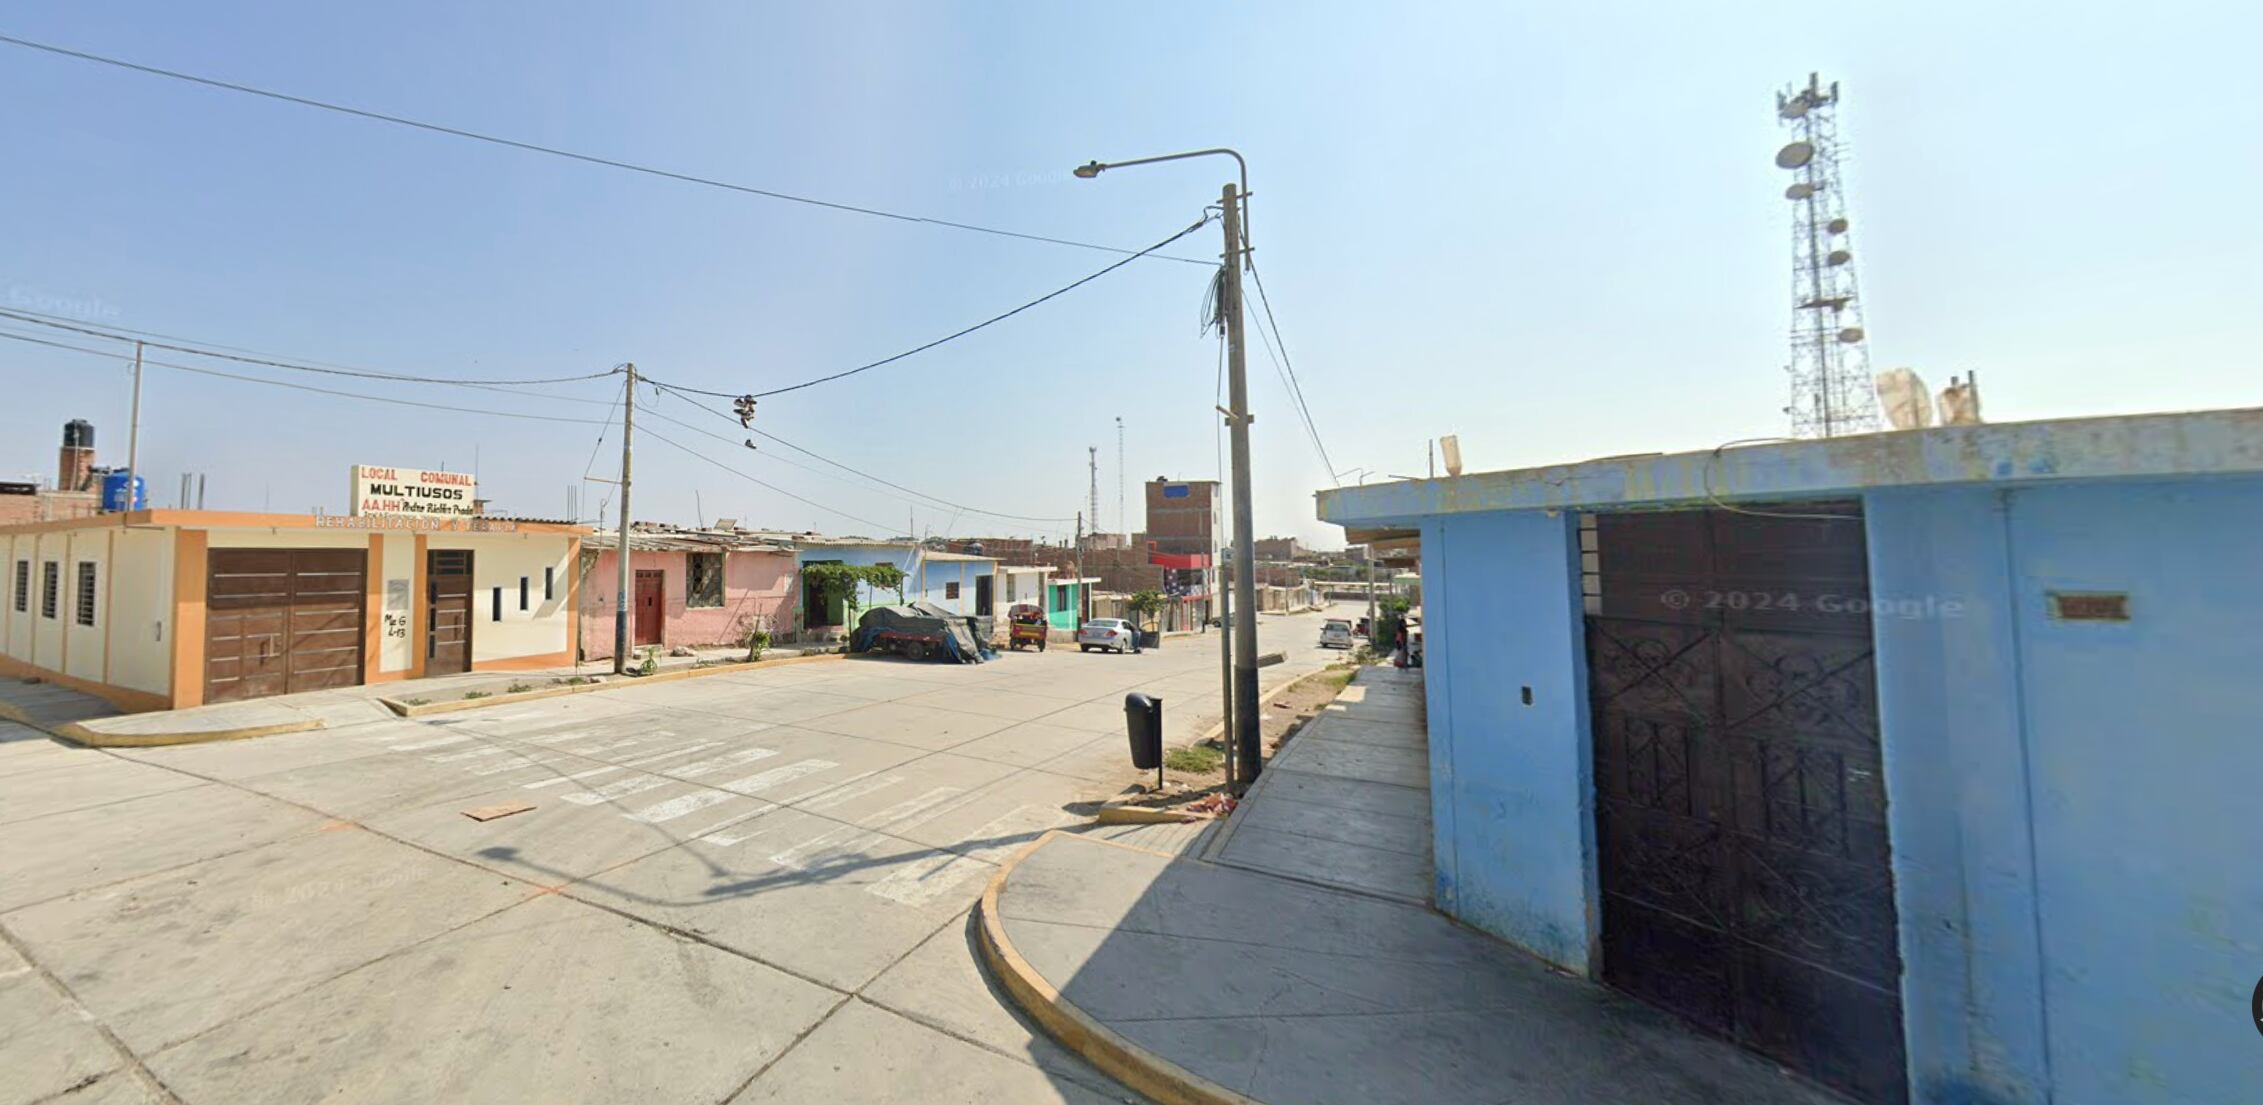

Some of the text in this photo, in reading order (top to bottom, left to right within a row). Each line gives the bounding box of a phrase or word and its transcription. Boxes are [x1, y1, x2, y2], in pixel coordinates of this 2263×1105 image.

[361, 466, 472, 486] LOCAL COMUNAL
[370, 483, 463, 500] MULTIUSOS
